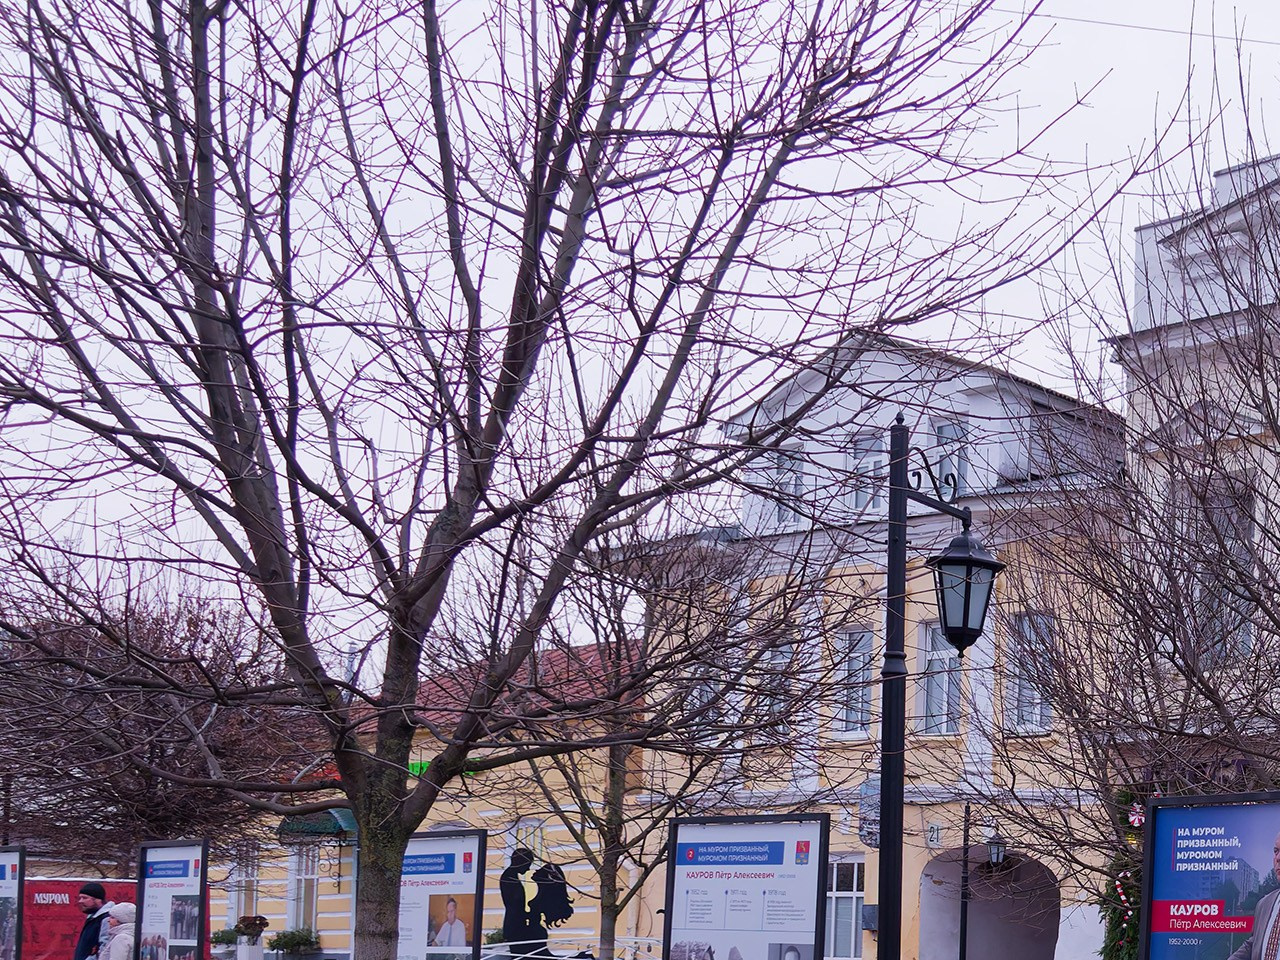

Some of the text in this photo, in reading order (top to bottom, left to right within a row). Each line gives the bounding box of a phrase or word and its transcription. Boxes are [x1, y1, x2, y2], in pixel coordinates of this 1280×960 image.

[929, 826, 940, 842] 21
[1178, 827, 1225, 836] НА МУРОМ
[1177, 836, 1241, 848] ПРИЗВАННЫЙ,
[1176, 851, 1222, 859] МУРОМОМ
[1176, 860, 1238, 871] ПРИЗНАННЫЙ
[33, 893, 70, 904] МУРОМ
[1170, 904, 1219, 916] КАУРОВ
[1169, 919, 1247, 931] Пётр Алексеевич
